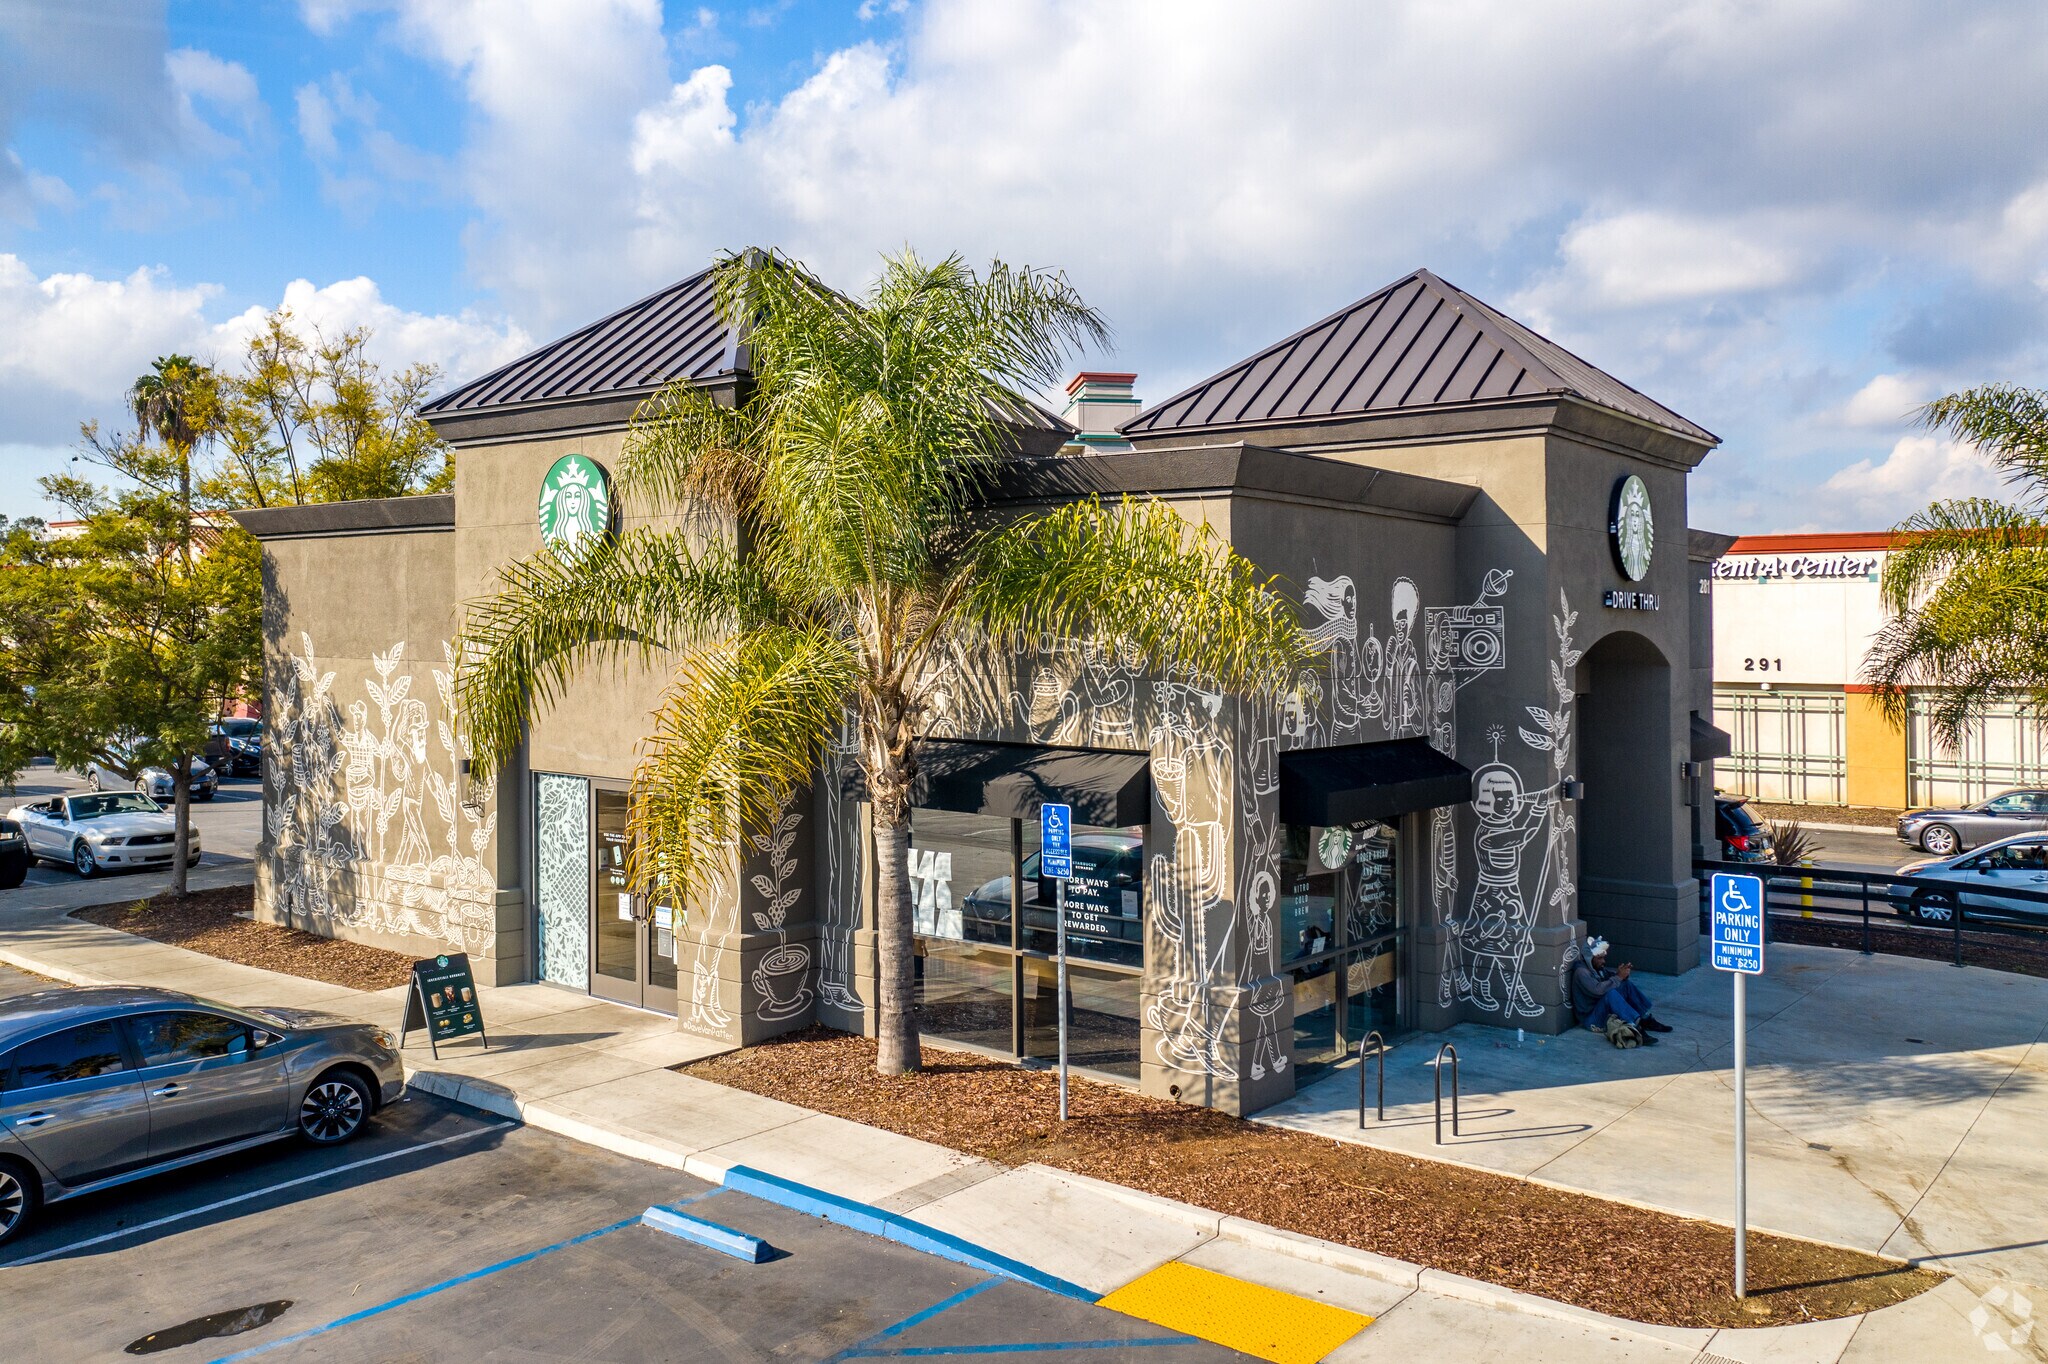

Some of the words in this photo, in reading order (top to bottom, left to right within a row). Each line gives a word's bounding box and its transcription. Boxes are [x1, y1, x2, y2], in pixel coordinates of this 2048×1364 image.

[1612, 590, 1637, 609] DRIVE
[1639, 593, 1660, 611] THRU
[1744, 657, 1782, 672] 291
[1086, 878, 1109, 888] WAYS
[1293, 882, 1310, 894] NITRO
[1083, 888, 1100, 897] PAY.
[1086, 903, 1109, 913] WAYS
[1294, 905, 1309, 917] BREW
[1071, 911, 1082, 919] TO
[1084, 912, 1099, 921] GET
[1716, 911, 1759, 929] PARKING
[1724, 927, 1751, 942] ONLY
[1721, 945, 1753, 957] MINIMUM
[1716, 955, 1733, 966] FINE
